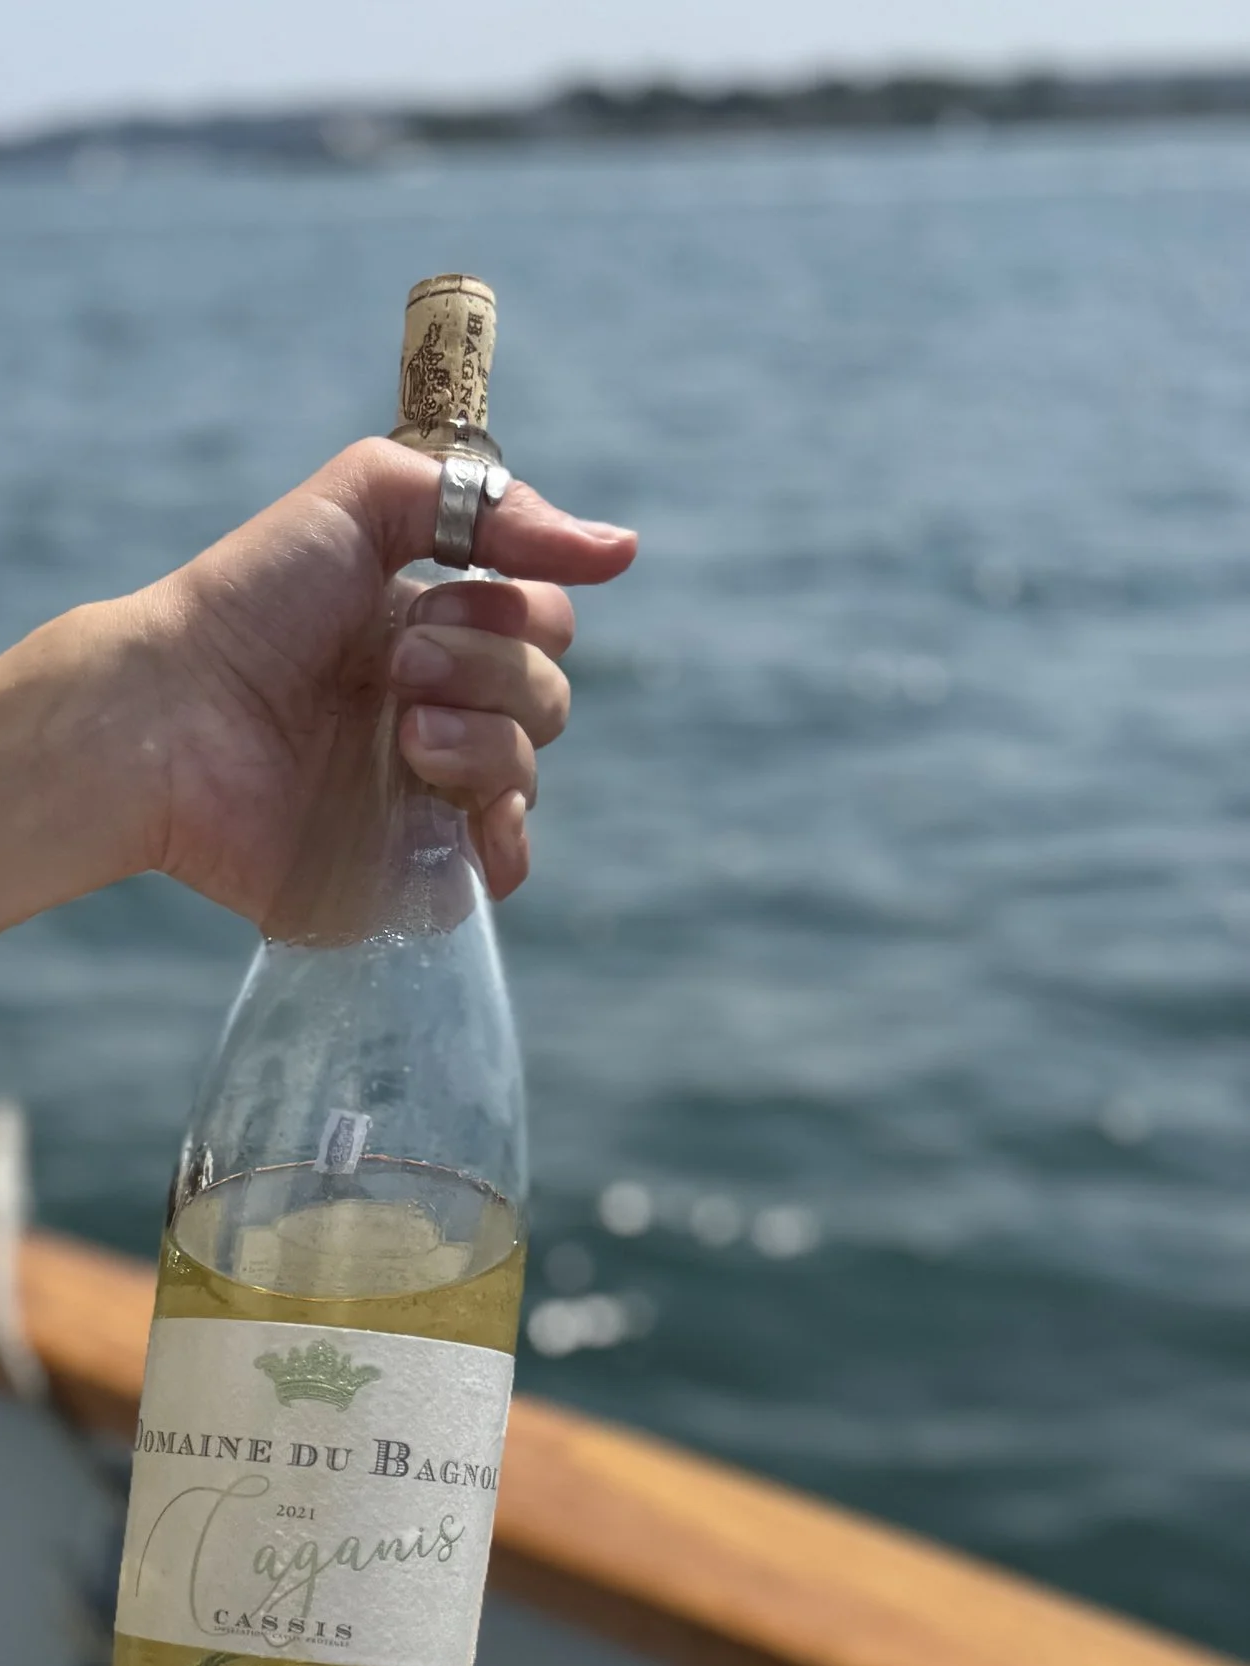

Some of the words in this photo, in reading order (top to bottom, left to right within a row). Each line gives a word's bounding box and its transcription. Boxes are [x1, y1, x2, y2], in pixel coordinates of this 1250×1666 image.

[287, 1442, 352, 1472] DU
[276, 1504, 315, 1521] 2021
[213, 1609, 352, 1640] CASSIS
